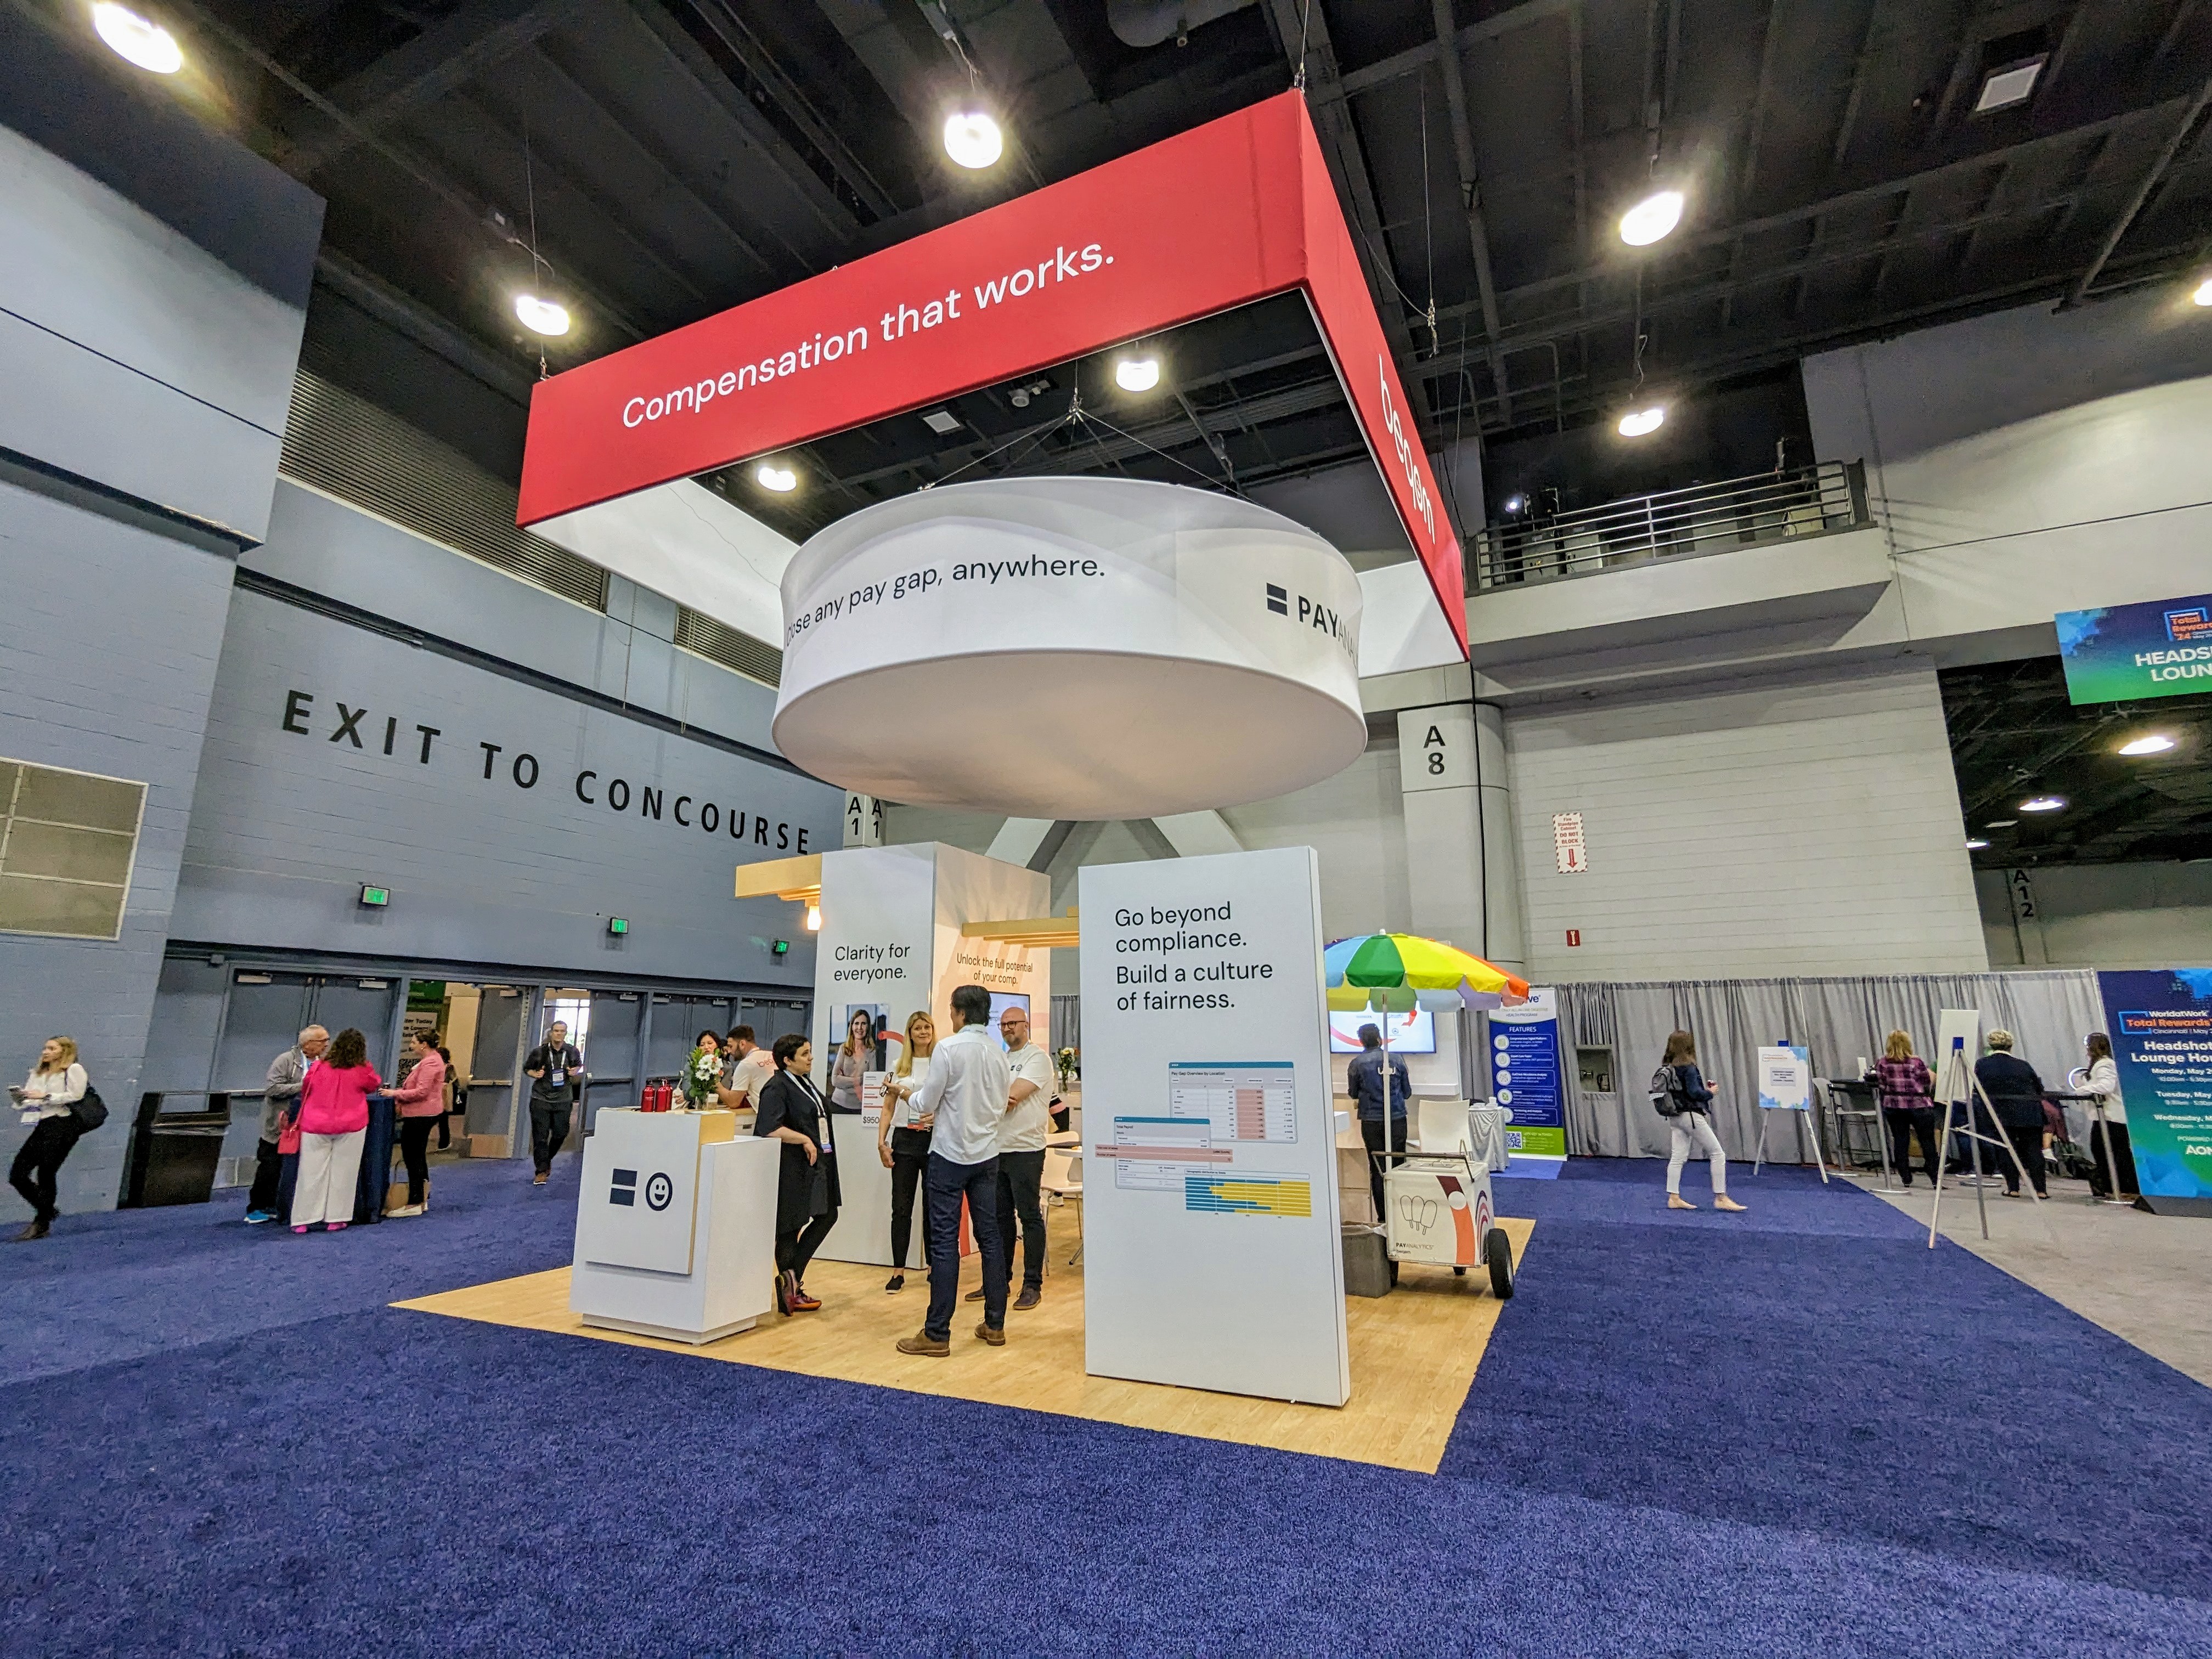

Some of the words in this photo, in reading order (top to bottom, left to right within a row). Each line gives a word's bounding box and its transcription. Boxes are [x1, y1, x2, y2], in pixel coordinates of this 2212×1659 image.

[623, 326, 867, 428] Compensation
[880, 288, 961, 342] that
[973, 242, 1114, 309] works.
[815, 595, 844, 623] any
[849, 580, 887, 614] pay
[893, 568, 943, 599] gap,
[952, 554, 1105, 584] anywhere.
[2135, 646, 2212, 667] HEADS
[282, 690, 441, 764] EXIT
[480, 742, 539, 789] TO
[575, 770, 809, 855] CONCOURSE
[1115, 909, 1144, 927] Go
[1151, 901, 1231, 928] beyond
[835, 945, 884, 963] Clarity
[889, 943, 910, 958] for
[1116, 931, 1247, 955] compliance.
[957, 952, 980, 966] Unlock
[982, 957, 994, 968] the
[995, 958, 1005, 969] full
[1006, 961, 1033, 973] potential
[1117, 964, 1167, 984] Build
[1175, 968, 1186, 982] a
[1193, 961, 1273, 981] culture
[834, 966, 907, 984] everyone.
[973, 970, 981, 981] of
[983, 974, 997, 985] your
[998, 975, 1018, 985] comp.
[1117, 992, 1137, 1011] of
[1143, 991, 1234, 1010] fairness.
[2131, 1052, 2185, 1064] Lounge
